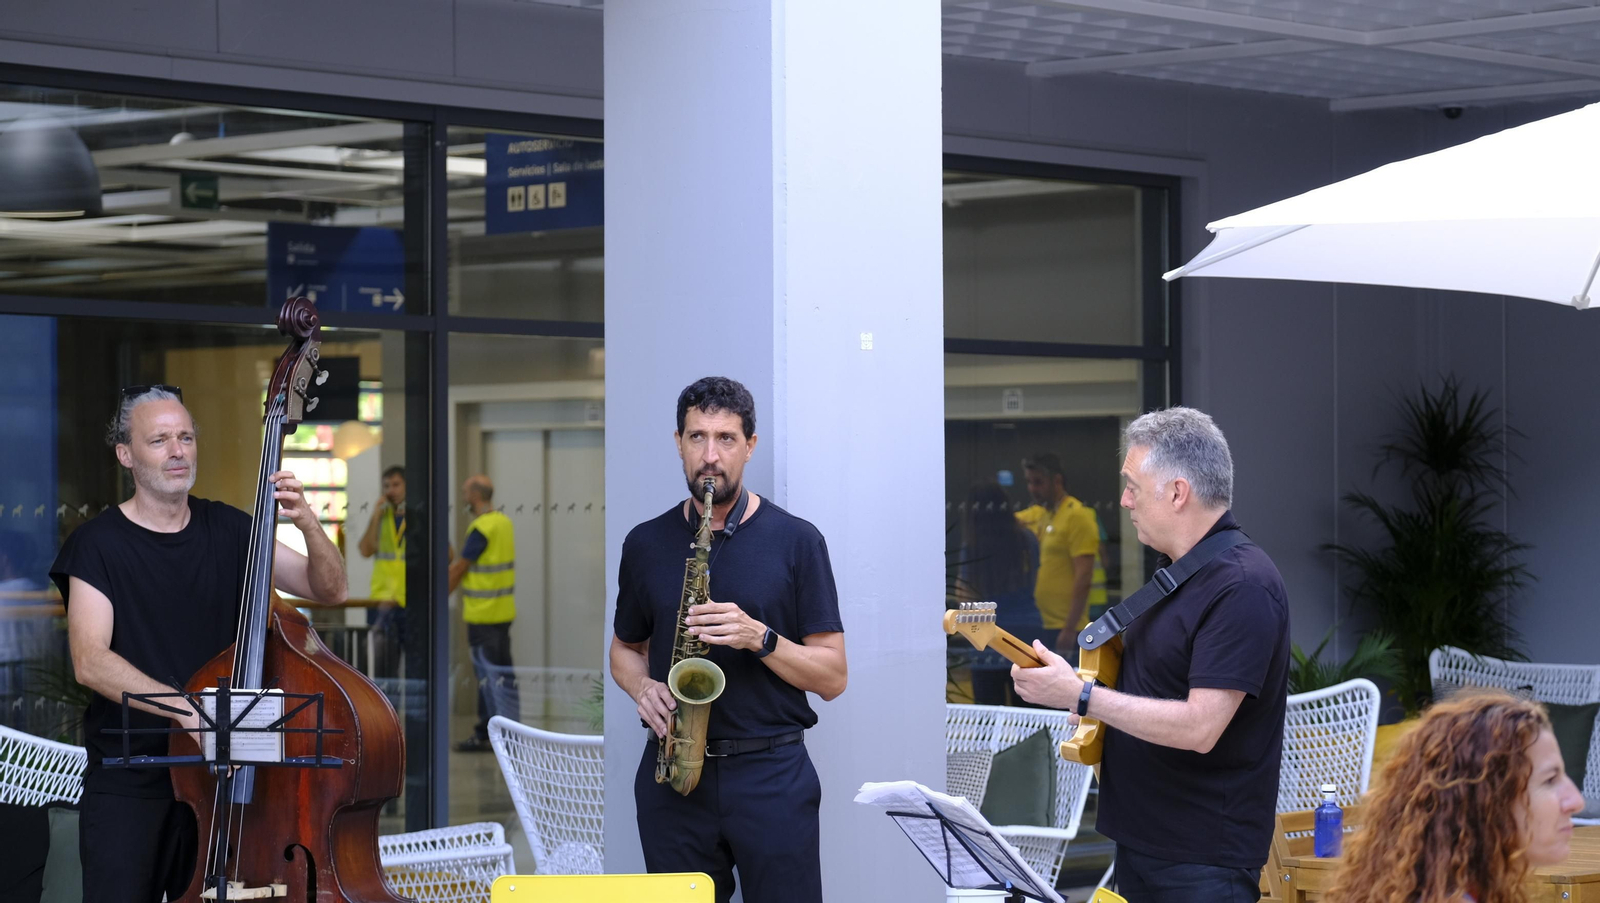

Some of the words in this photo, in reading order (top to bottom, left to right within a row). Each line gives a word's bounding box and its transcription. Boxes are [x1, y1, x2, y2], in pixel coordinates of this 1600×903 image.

[508, 164, 545, 177] Servicios
[553, 161, 571, 173] Sala
[288, 241, 315, 253] Salida
